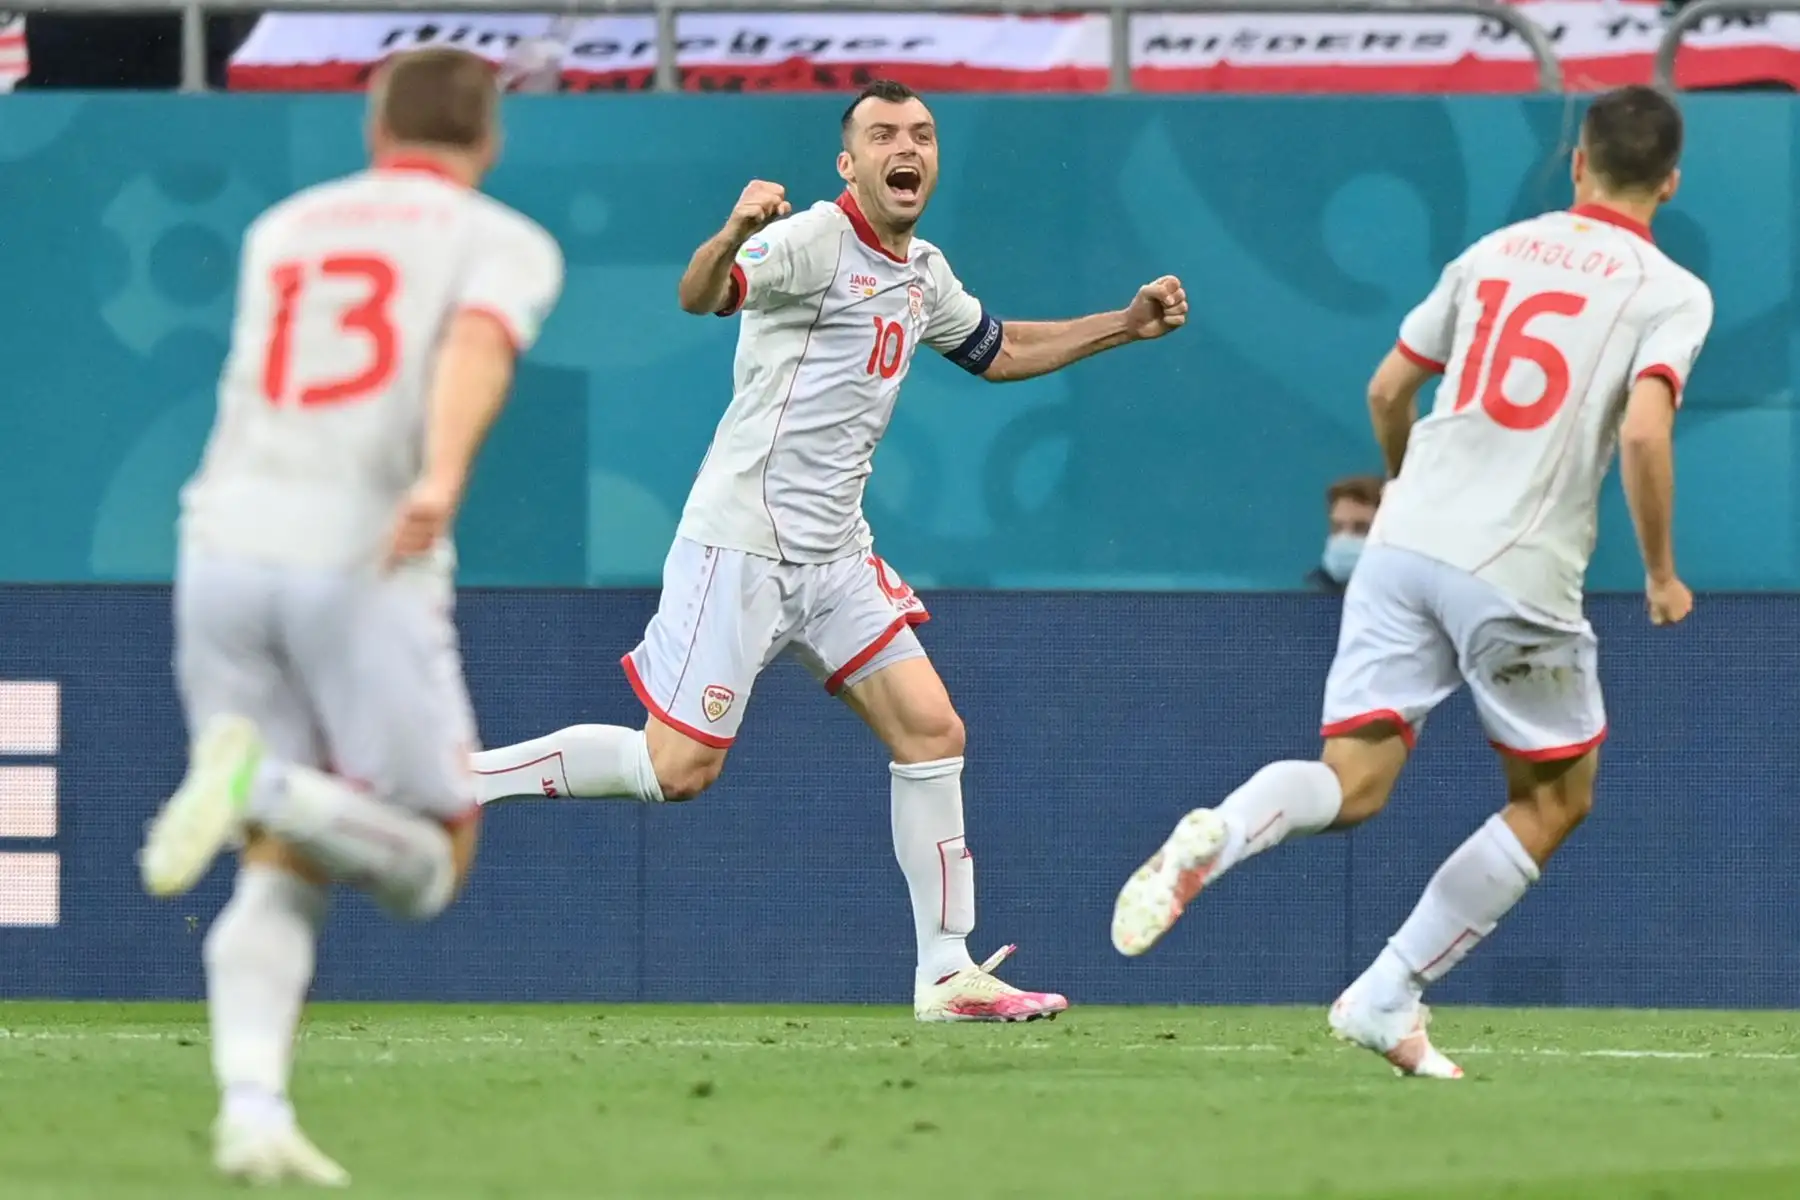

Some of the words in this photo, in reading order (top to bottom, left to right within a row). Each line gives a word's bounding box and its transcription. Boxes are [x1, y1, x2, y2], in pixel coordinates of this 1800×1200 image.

[848, 273, 877, 287] JAKO
[1498, 235, 1624, 277] NIKOLOV
[262, 253, 400, 408] 13
[866, 315, 905, 379] 10
[1453, 279, 1588, 431] 16
